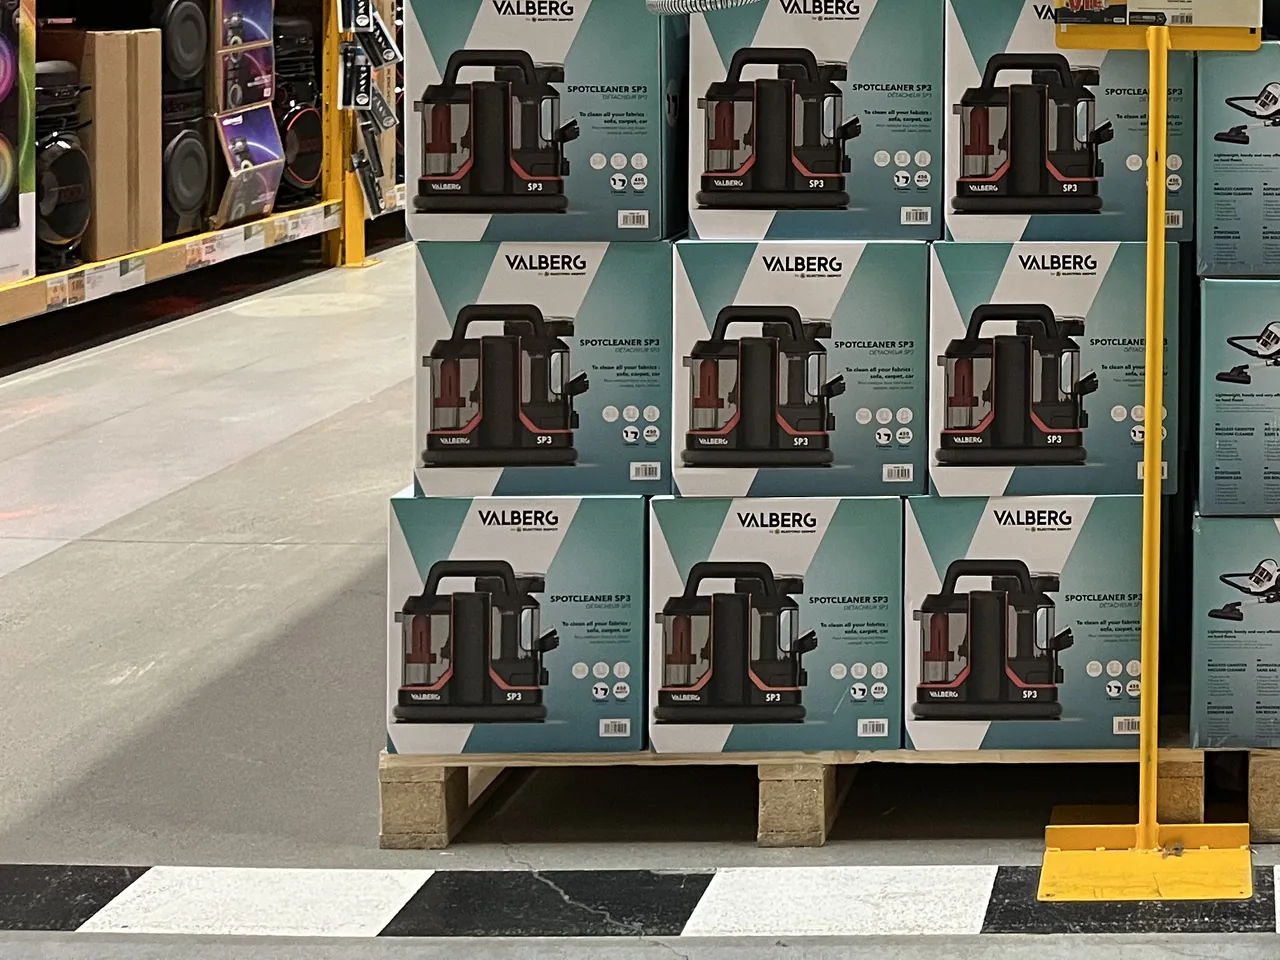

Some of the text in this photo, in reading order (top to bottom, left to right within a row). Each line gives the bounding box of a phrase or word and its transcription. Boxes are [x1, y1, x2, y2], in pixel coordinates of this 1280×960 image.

[492, 0, 574, 15] VALBERG
[779, 0, 860, 15] VALBERG
[567, 85, 648, 93] SPOTCLEANER SP3
[852, 83, 932, 91] SPOTCLEANER SP3
[527, 183, 543, 191] SP3
[809, 179, 824, 188] SP3
[505, 255, 587, 270] VALBERG
[762, 256, 843, 272] VALBERG
[1018, 255, 1097, 270] VALBERG
[579, 338, 642, 347] SPOTCLEANER
[834, 341, 914, 349] SPOTCLEANER SP3
[793, 438, 809, 446] SP3
[478, 510, 559, 526] VALBERG
[737, 512, 817, 528] VALBERG
[993, 510, 1072, 526] VALBERG
[550, 595, 613, 603] SPOTCLEANER
[809, 596, 889, 604] SPOTCLEANER SP3
[1065, 594, 1126, 602] SPOTCLEANER
[506, 692, 522, 701] SP3
[1022, 690, 1038, 699] SP3
